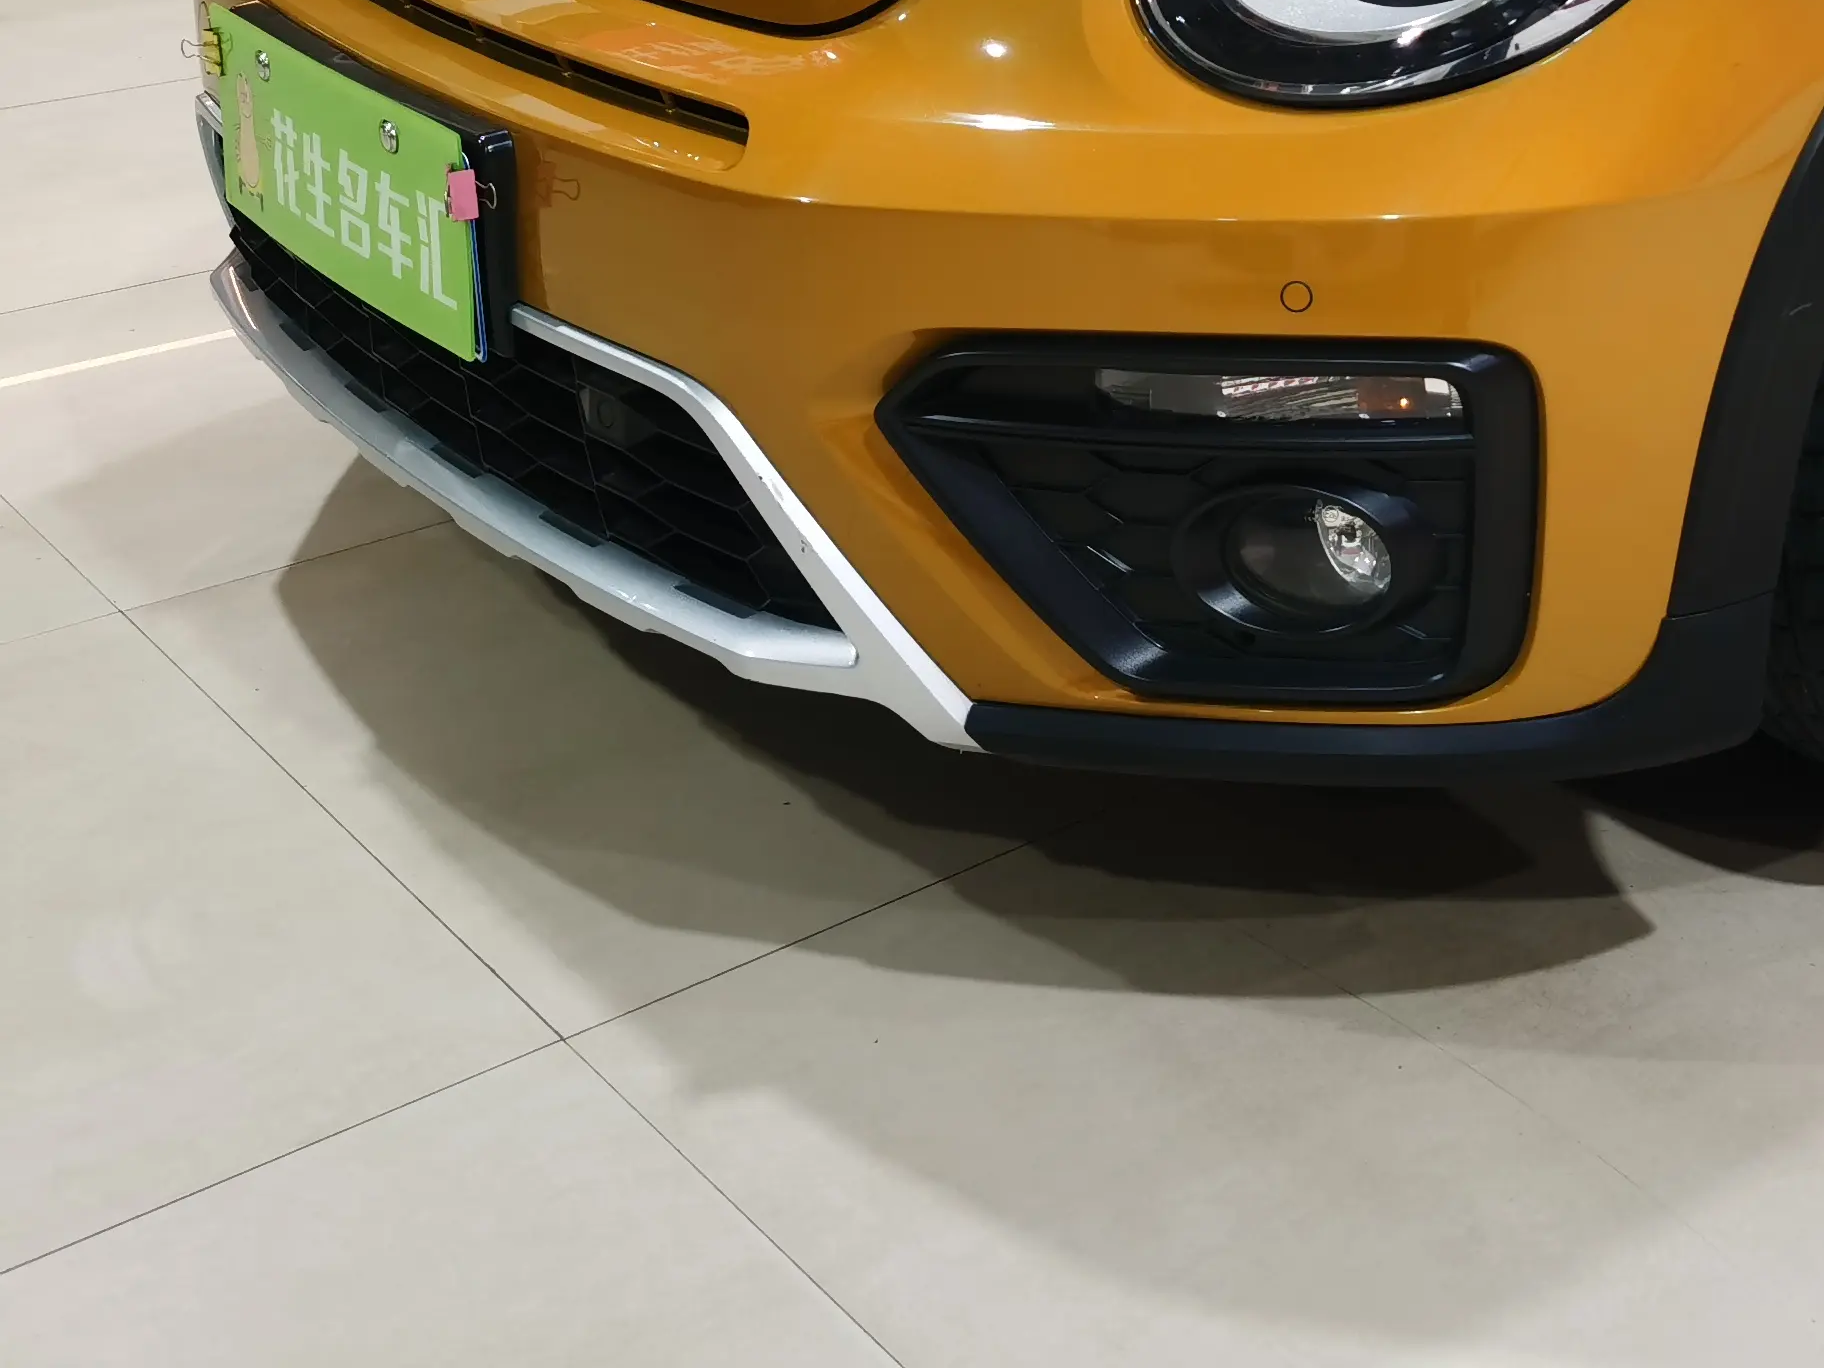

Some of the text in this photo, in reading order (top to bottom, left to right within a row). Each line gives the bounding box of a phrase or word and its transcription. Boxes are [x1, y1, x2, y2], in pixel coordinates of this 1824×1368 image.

[270, 108, 458, 311] 花生名车汇
